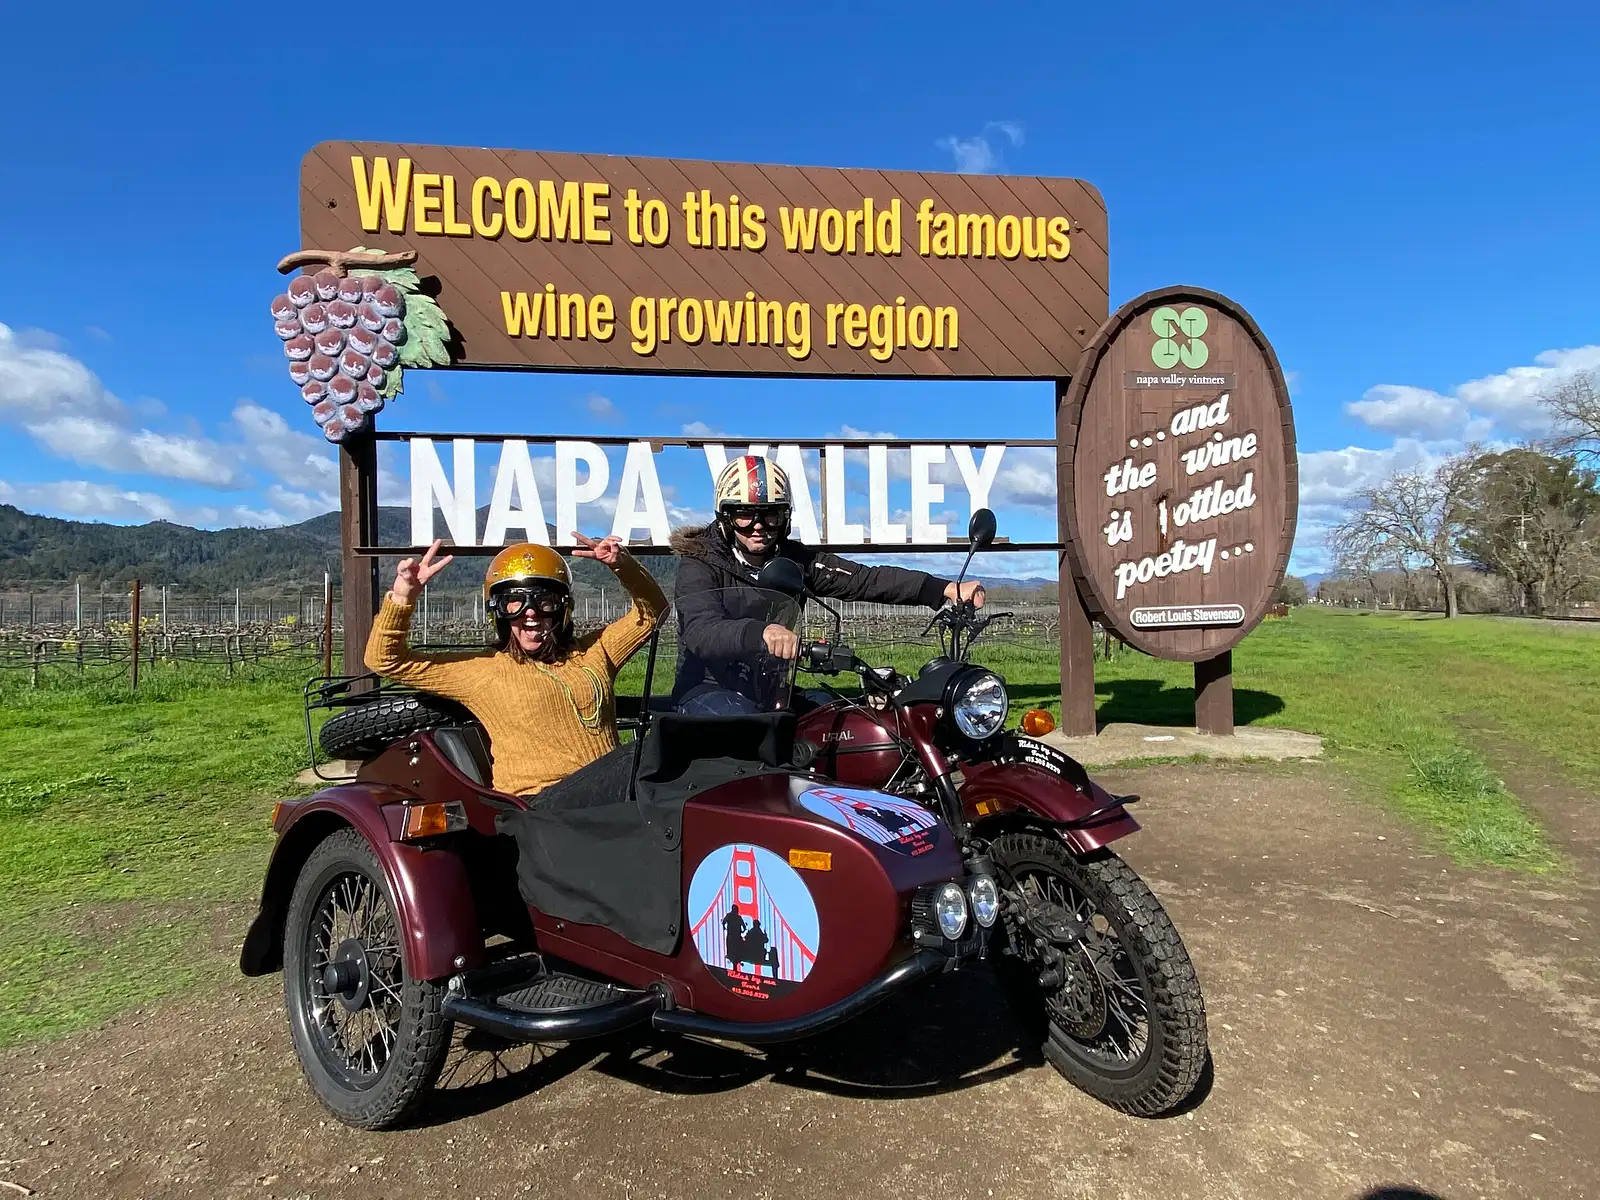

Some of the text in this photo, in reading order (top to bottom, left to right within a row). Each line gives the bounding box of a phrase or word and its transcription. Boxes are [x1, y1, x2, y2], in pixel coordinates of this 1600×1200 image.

[351, 155, 1071, 260] WELCOME to this world famous
[501, 283, 959, 361] wine growing region
[1136, 374, 1225, 387] napa valley vintners
[410, 437, 672, 547] NAPA
[1103, 431, 1257, 497] the wine
[1103, 510, 1133, 546] is
[1135, 609, 1240, 623] Robert Louis Stevenson
